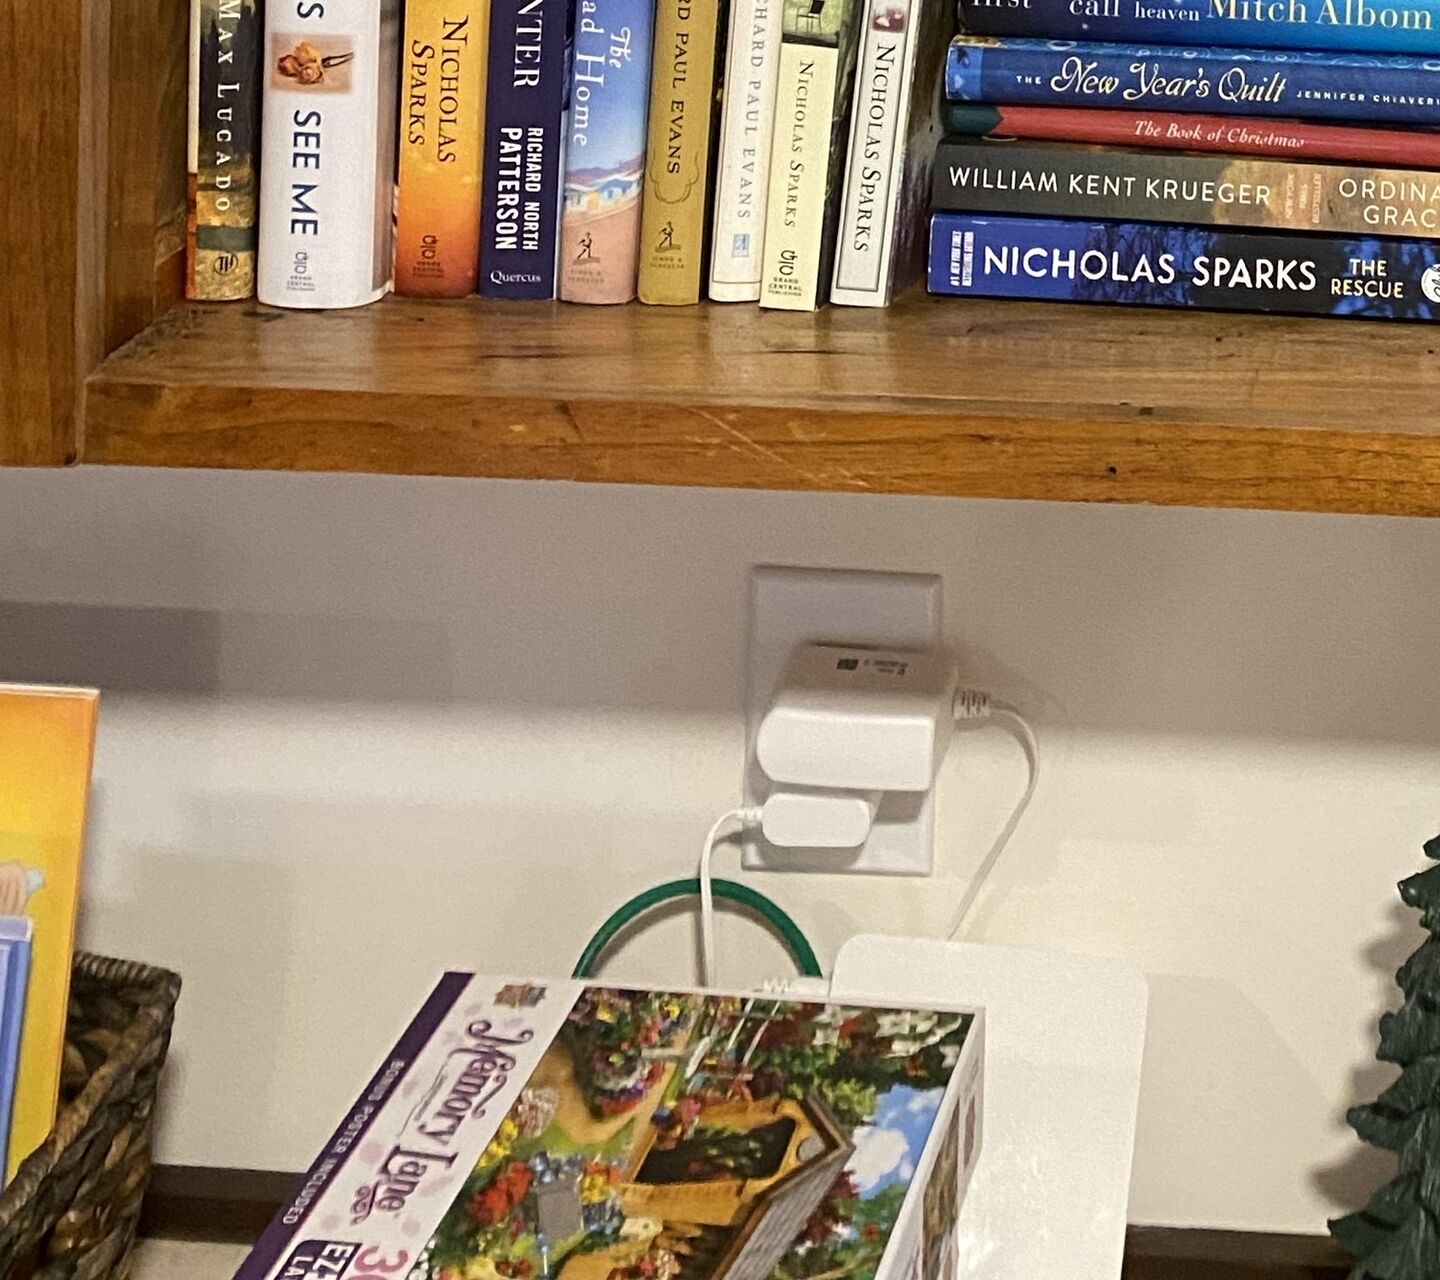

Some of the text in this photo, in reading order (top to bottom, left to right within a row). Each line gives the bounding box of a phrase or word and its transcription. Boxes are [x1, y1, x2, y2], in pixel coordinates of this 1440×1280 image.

[1134, 0, 1200, 22] heaven
[608, 26, 633, 70] The
[670, 31, 692, 91] PAUL
[1015, 74, 1042, 85] THE
[1050, 56, 1120, 94] New
[1122, 61, 1210, 100] Year's
[1218, 66, 1287, 104] Quilt
[1296, 89, 1366, 103] JENNIFER
[407, 40, 436, 147] SPARKS
[437, 15, 470, 164] NICHOLAS
[572, 51, 607, 146] Home
[744, 79, 763, 137] PAUL
[215, 82, 241, 212] LUCADO
[666, 99, 685, 175] EVANS
[784, 60, 815, 229] NICHOLAS SPARKS
[853, 42, 896, 253] NICHOLAS SPARKS
[1134, 119, 1306, 150] The Book of Christmas
[289, 108, 323, 237] SEE ME
[494, 126, 524, 251] PATTERSON
[521, 126, 545, 251] RICHARD NORTH
[737, 148, 757, 220] EVANS
[948, 166, 1272, 207] WILLIAM KENT KRUEGER
[489, 269, 543, 286] Quercus
[983, 245, 1176, 286] NICHOLAS
[1191, 255, 1318, 292] SPARKS
[1331, 278, 1405, 300] RESCUE
[1350, 258, 1388, 278] THE
[417, 1020, 535, 1146] Memory
[333, 1105, 375, 1154] POSTER
[281, 1157, 338, 1225] INCLUDED
[376, 1144, 459, 1212] Lane
